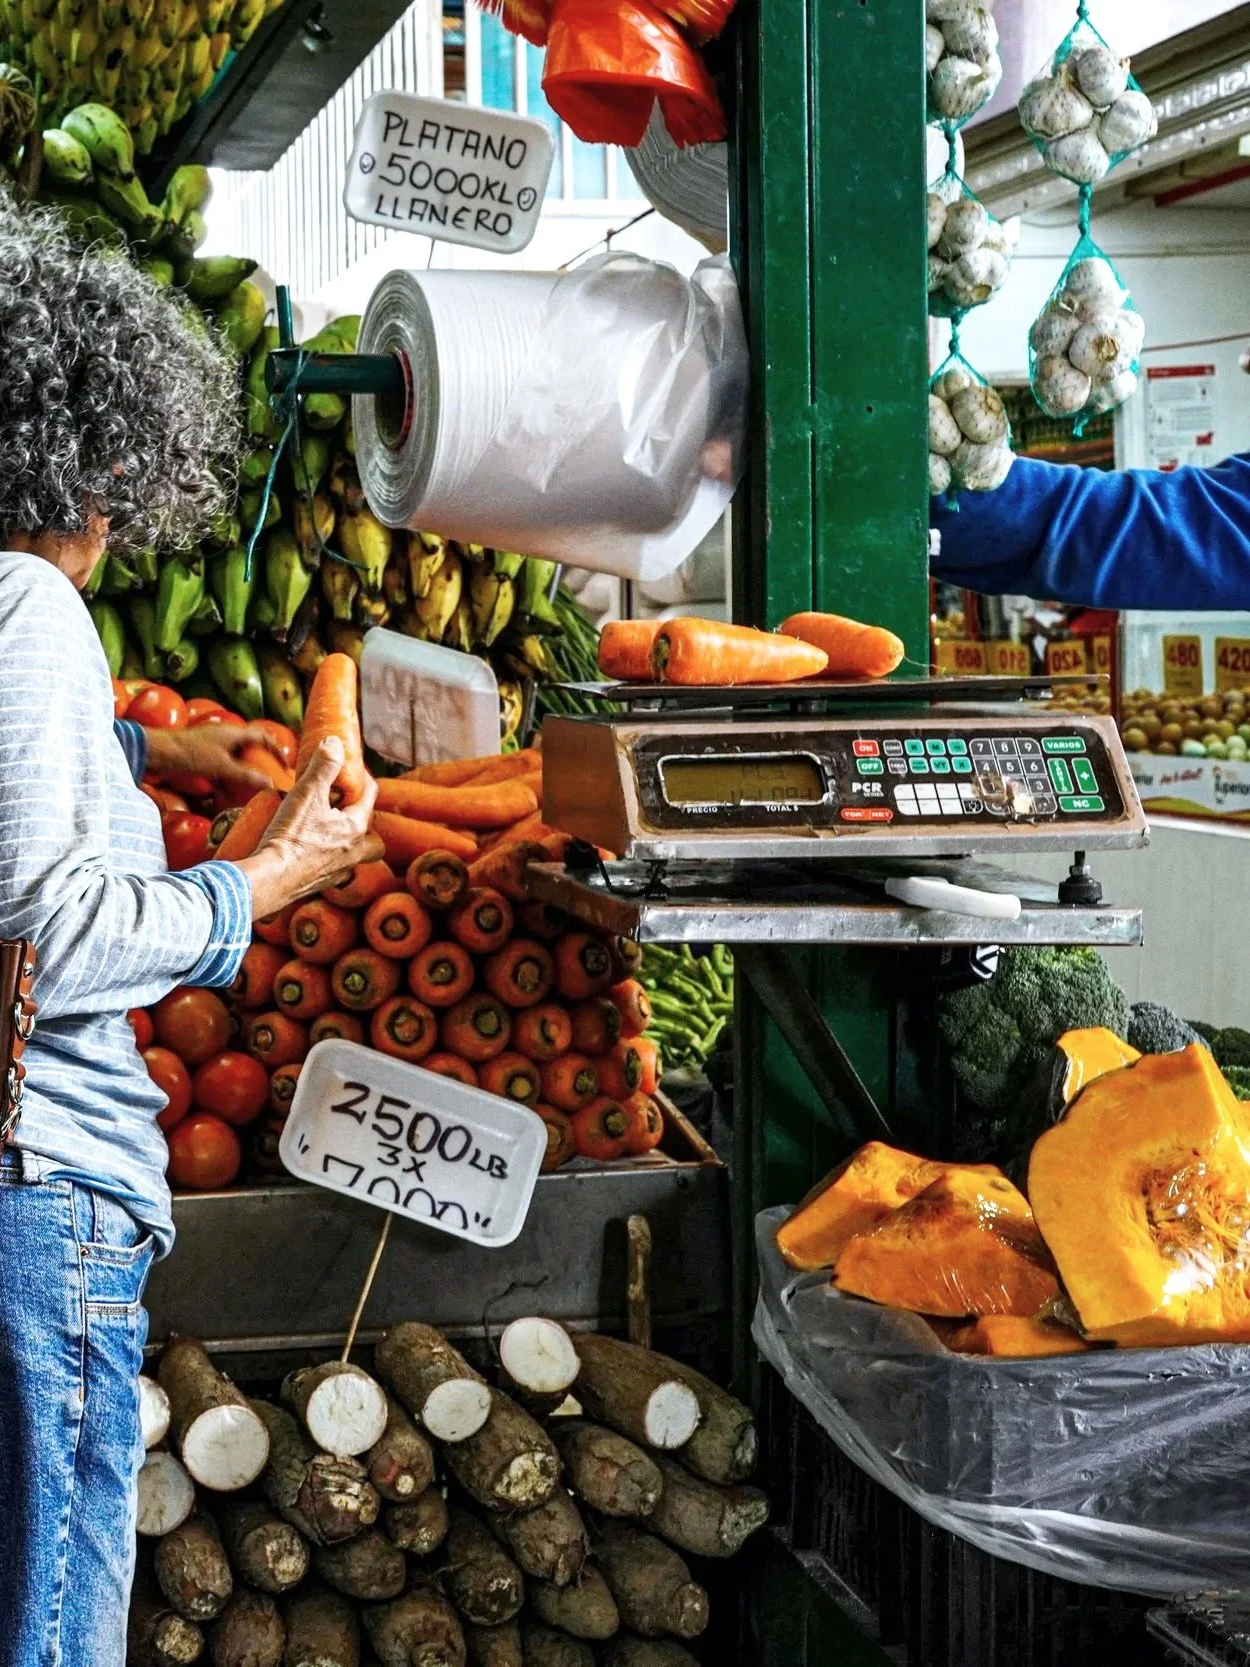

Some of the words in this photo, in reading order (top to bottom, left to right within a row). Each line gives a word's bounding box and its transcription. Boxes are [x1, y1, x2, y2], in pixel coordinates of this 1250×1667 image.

[383, 111, 527, 169] PLATANO
[378, 152, 514, 205] 5000KL
[375, 194, 513, 236] LLANERO
[977, 743, 984, 752] 7
[1001, 743, 1009, 753] 8
[1024, 743, 1032, 752] 9
[982, 762, 990, 771] 4
[1006, 762, 1014, 771] 5
[1030, 762, 1038, 771] 6
[852, 782, 882, 793] PCR
[1035, 781, 1043, 790] 3
[1072, 800, 1090, 808] NC
[687, 806, 718, 814] PRECIO
[377, 1142, 427, 1182] 3X
